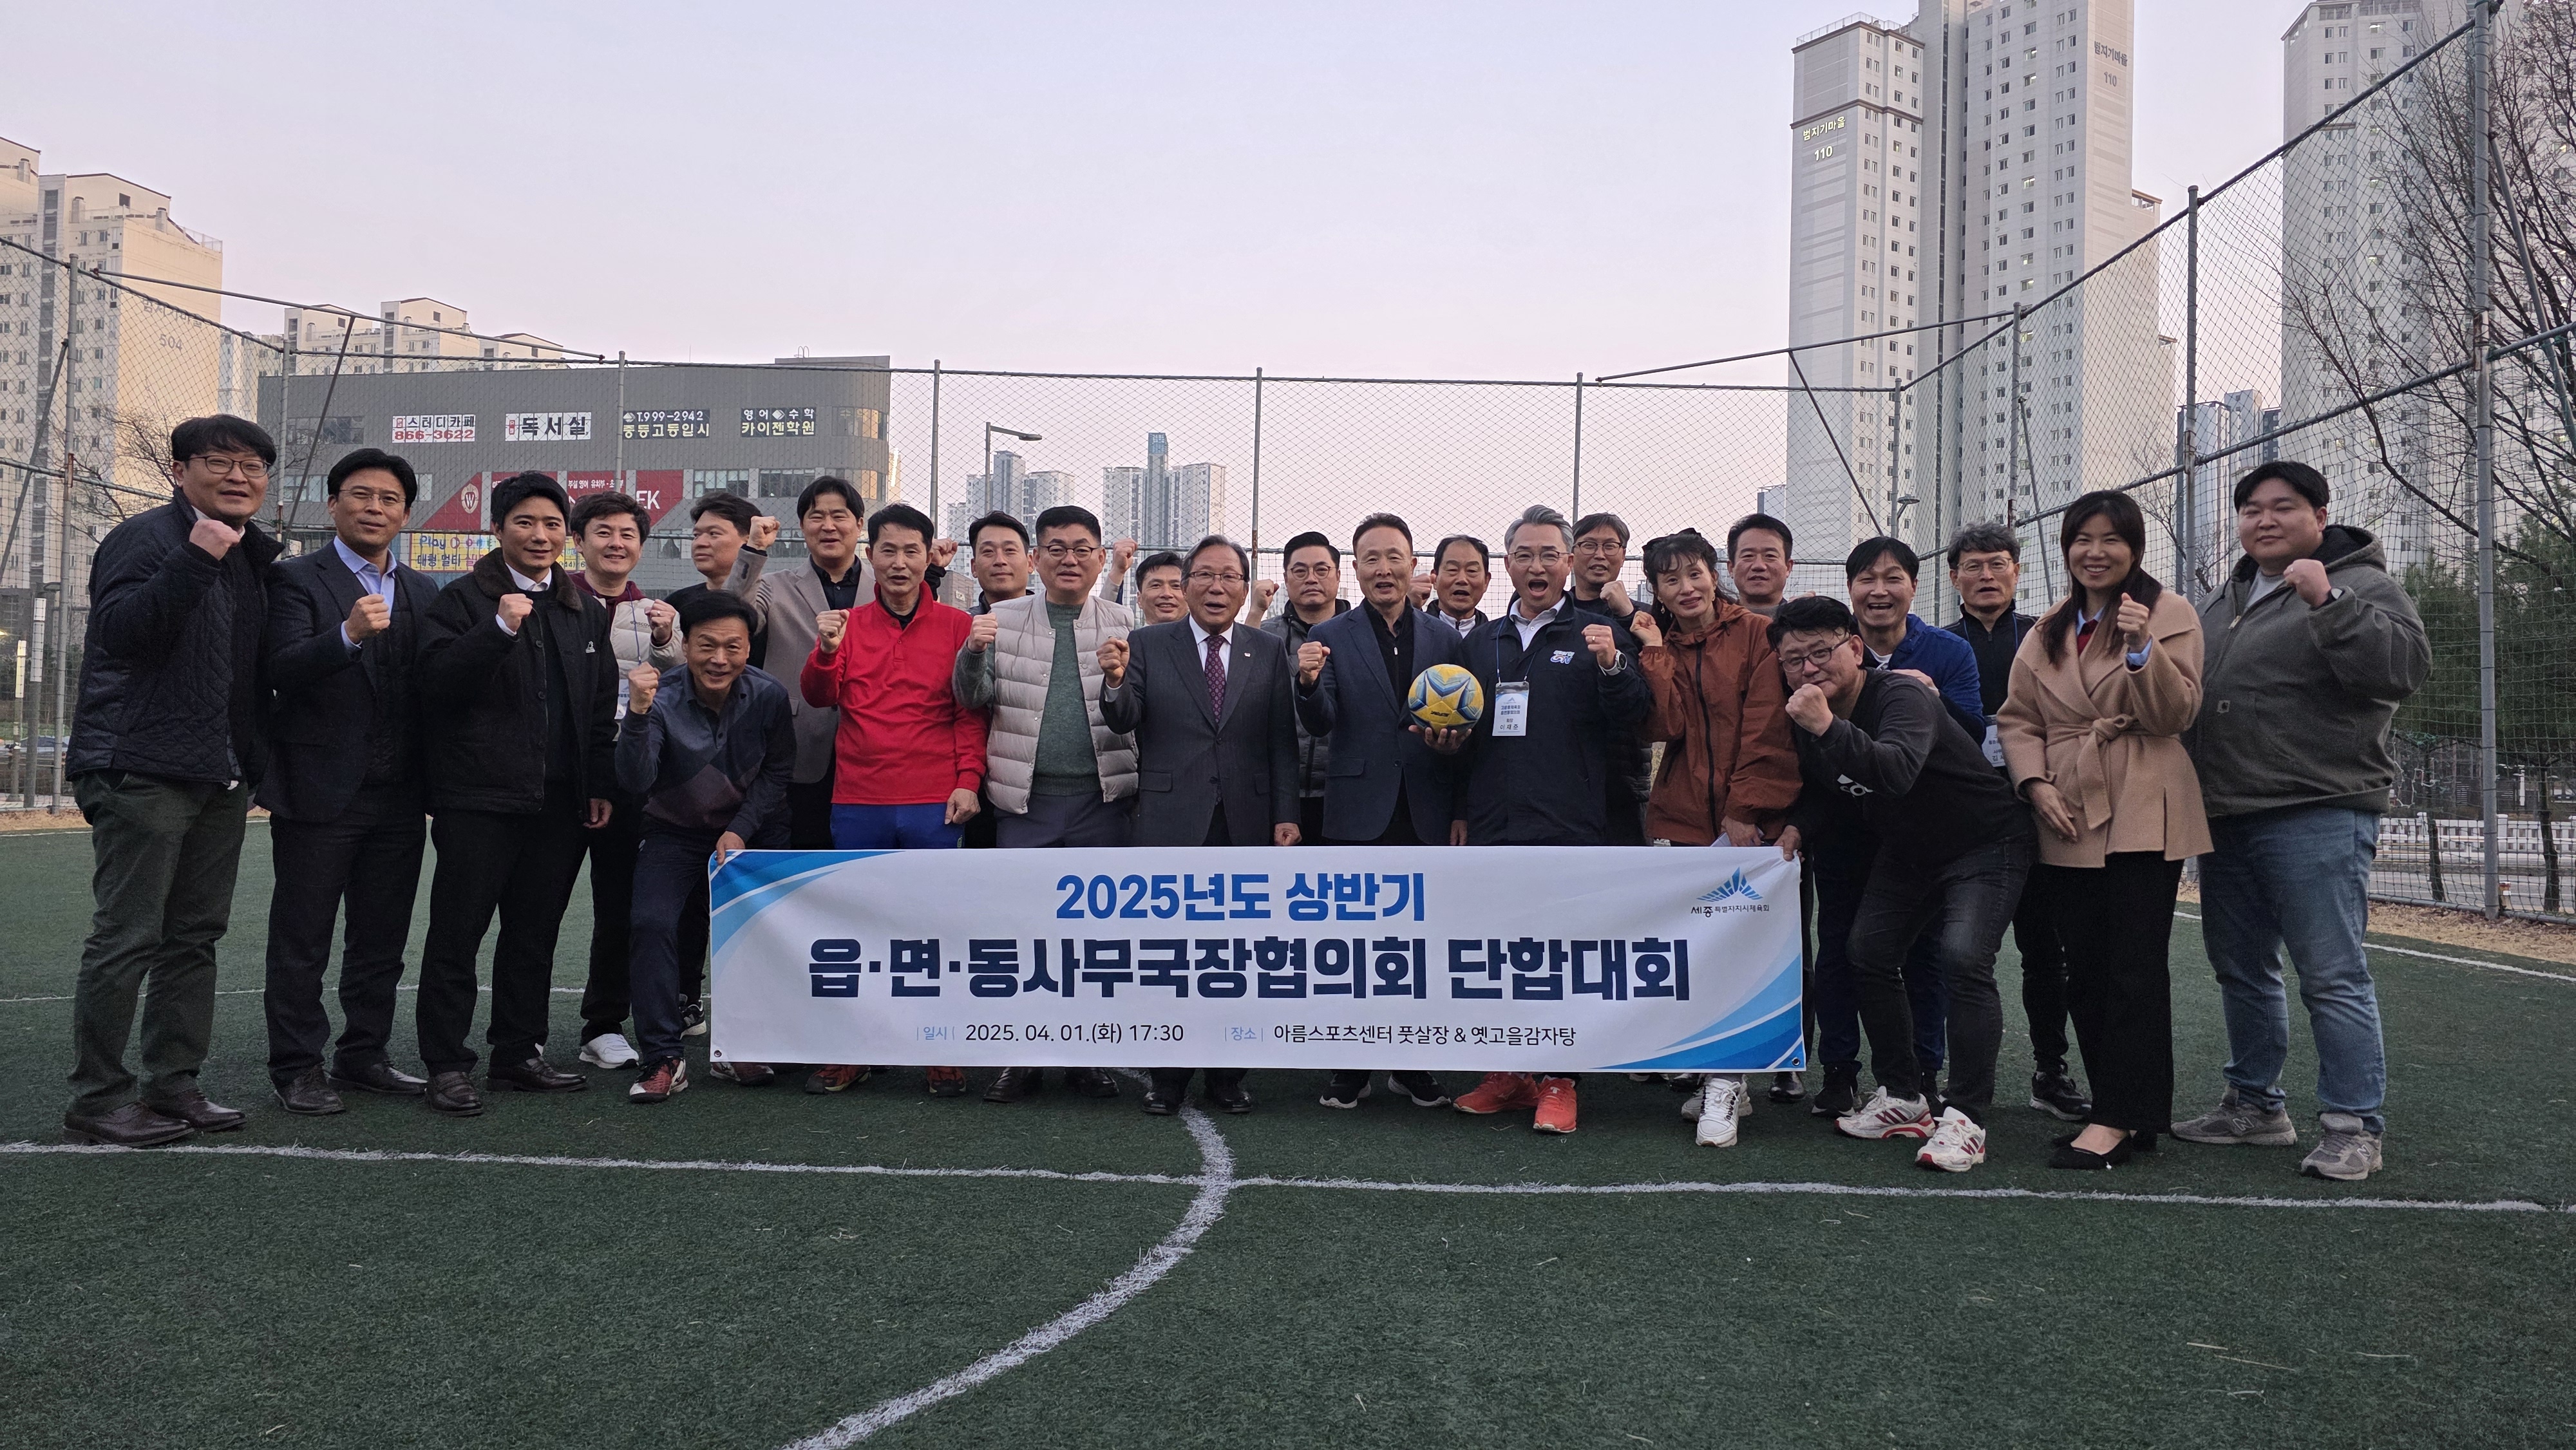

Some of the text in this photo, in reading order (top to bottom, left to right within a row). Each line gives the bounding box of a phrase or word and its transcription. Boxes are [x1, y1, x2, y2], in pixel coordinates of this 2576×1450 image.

[2104, 71, 2117, 87] 110
[1803, 116, 1846, 141] 범지기마을
[1814, 146, 1833, 161] 110
[160, 334, 183, 352] 504
[408, 415, 475, 428] 스터디카페
[636, 410, 704, 422] T.999-2942
[743, 408, 815, 420] 영어 수학
[521, 416, 586, 436] 독서실
[741, 420, 815, 436] 카이젠학원
[394, 429, 475, 440] 866-3622
[419, 535, 447, 550] Play
[417, 554, 437, 567] 대형
[1056, 872, 1425, 921] 2025년도 상반기
[1448, 937, 1690, 1001] 단합대회
[965, 1024, 1019, 1042] 2025.
[1025, 1024, 1054, 1042] 04.
[1129, 1024, 1184, 1042] 17:30
[1274, 1024, 1392, 1044] 아름스포츠센터
[1397, 1025, 1450, 1045] 풋살장
[1454, 1027, 1467, 1043] &
[1471, 1026, 1577, 1047] 옛고을감자탕
